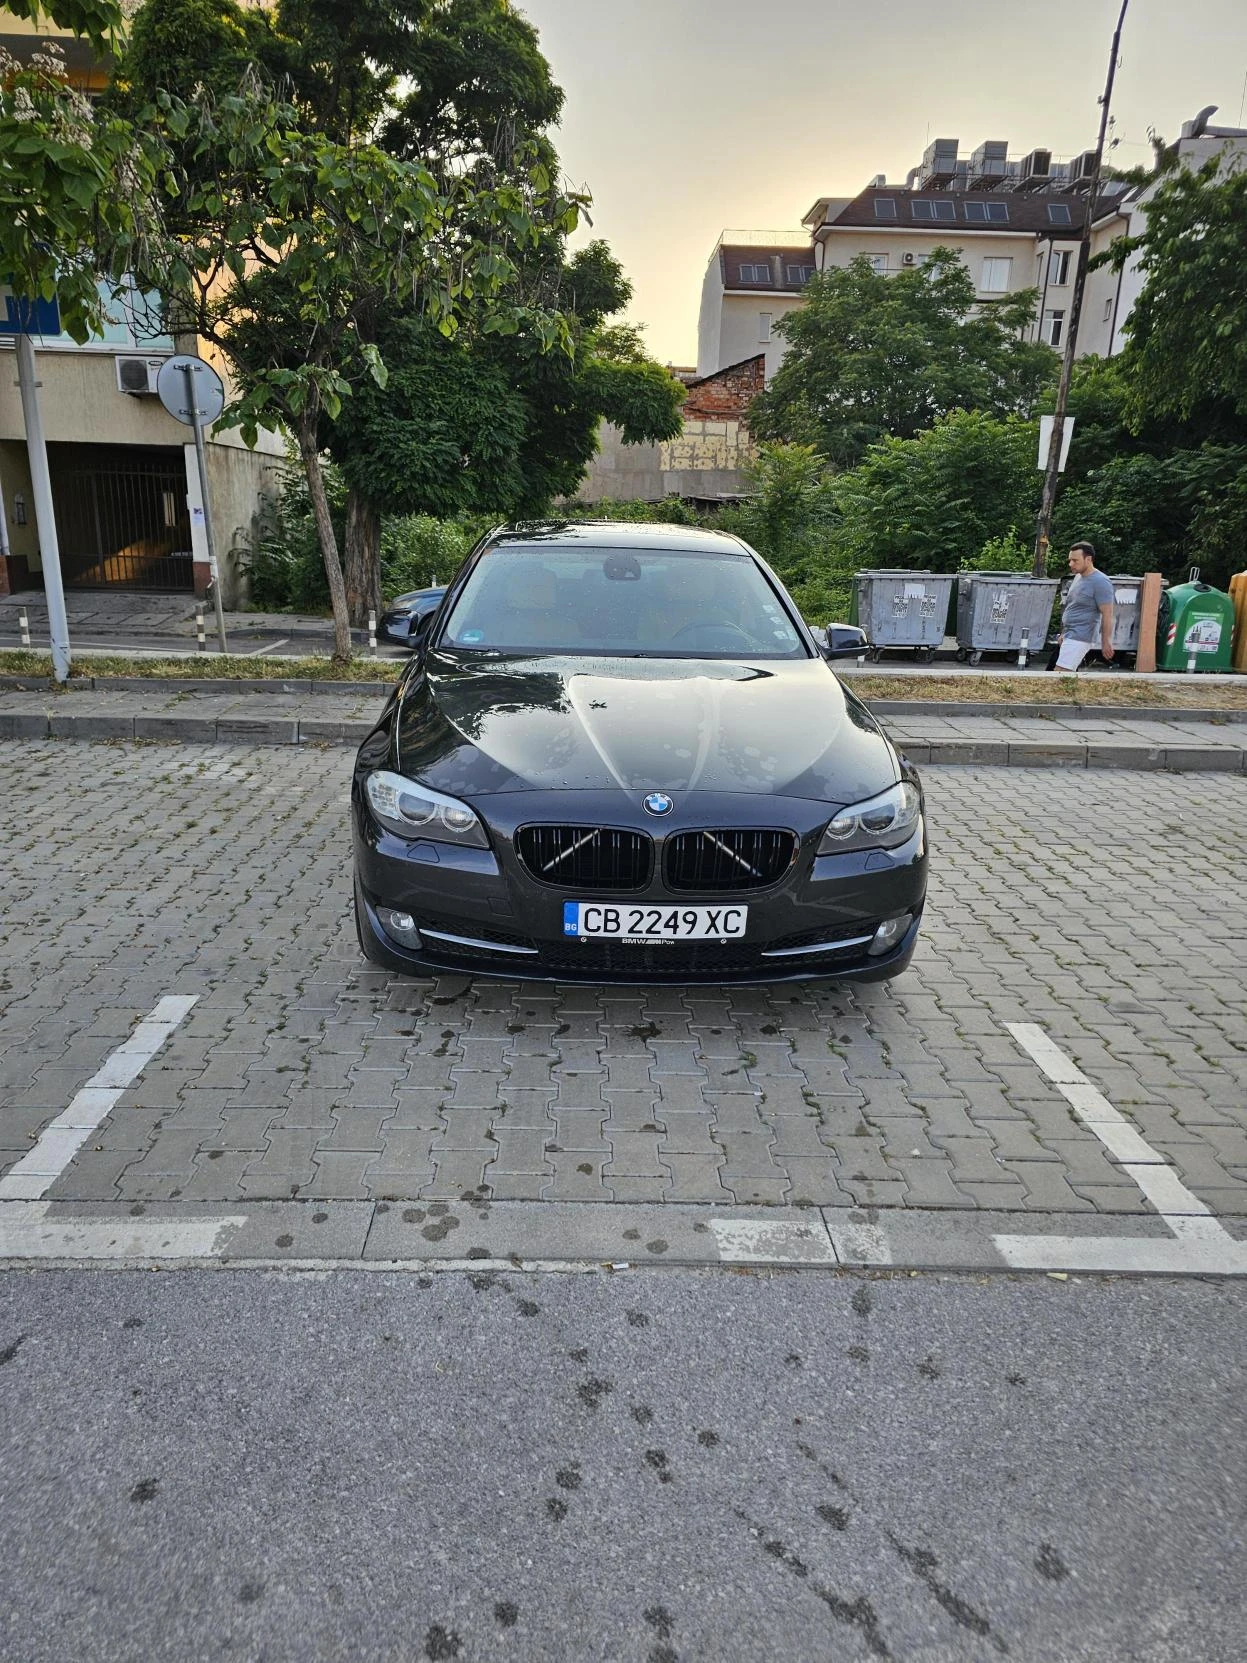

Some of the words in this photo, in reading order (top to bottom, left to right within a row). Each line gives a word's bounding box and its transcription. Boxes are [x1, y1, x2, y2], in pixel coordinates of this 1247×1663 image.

[564, 923, 577, 931] BG
[584, 908, 621, 933] CB
[628, 910, 698, 935] 2249
[704, 910, 741, 935] XC
